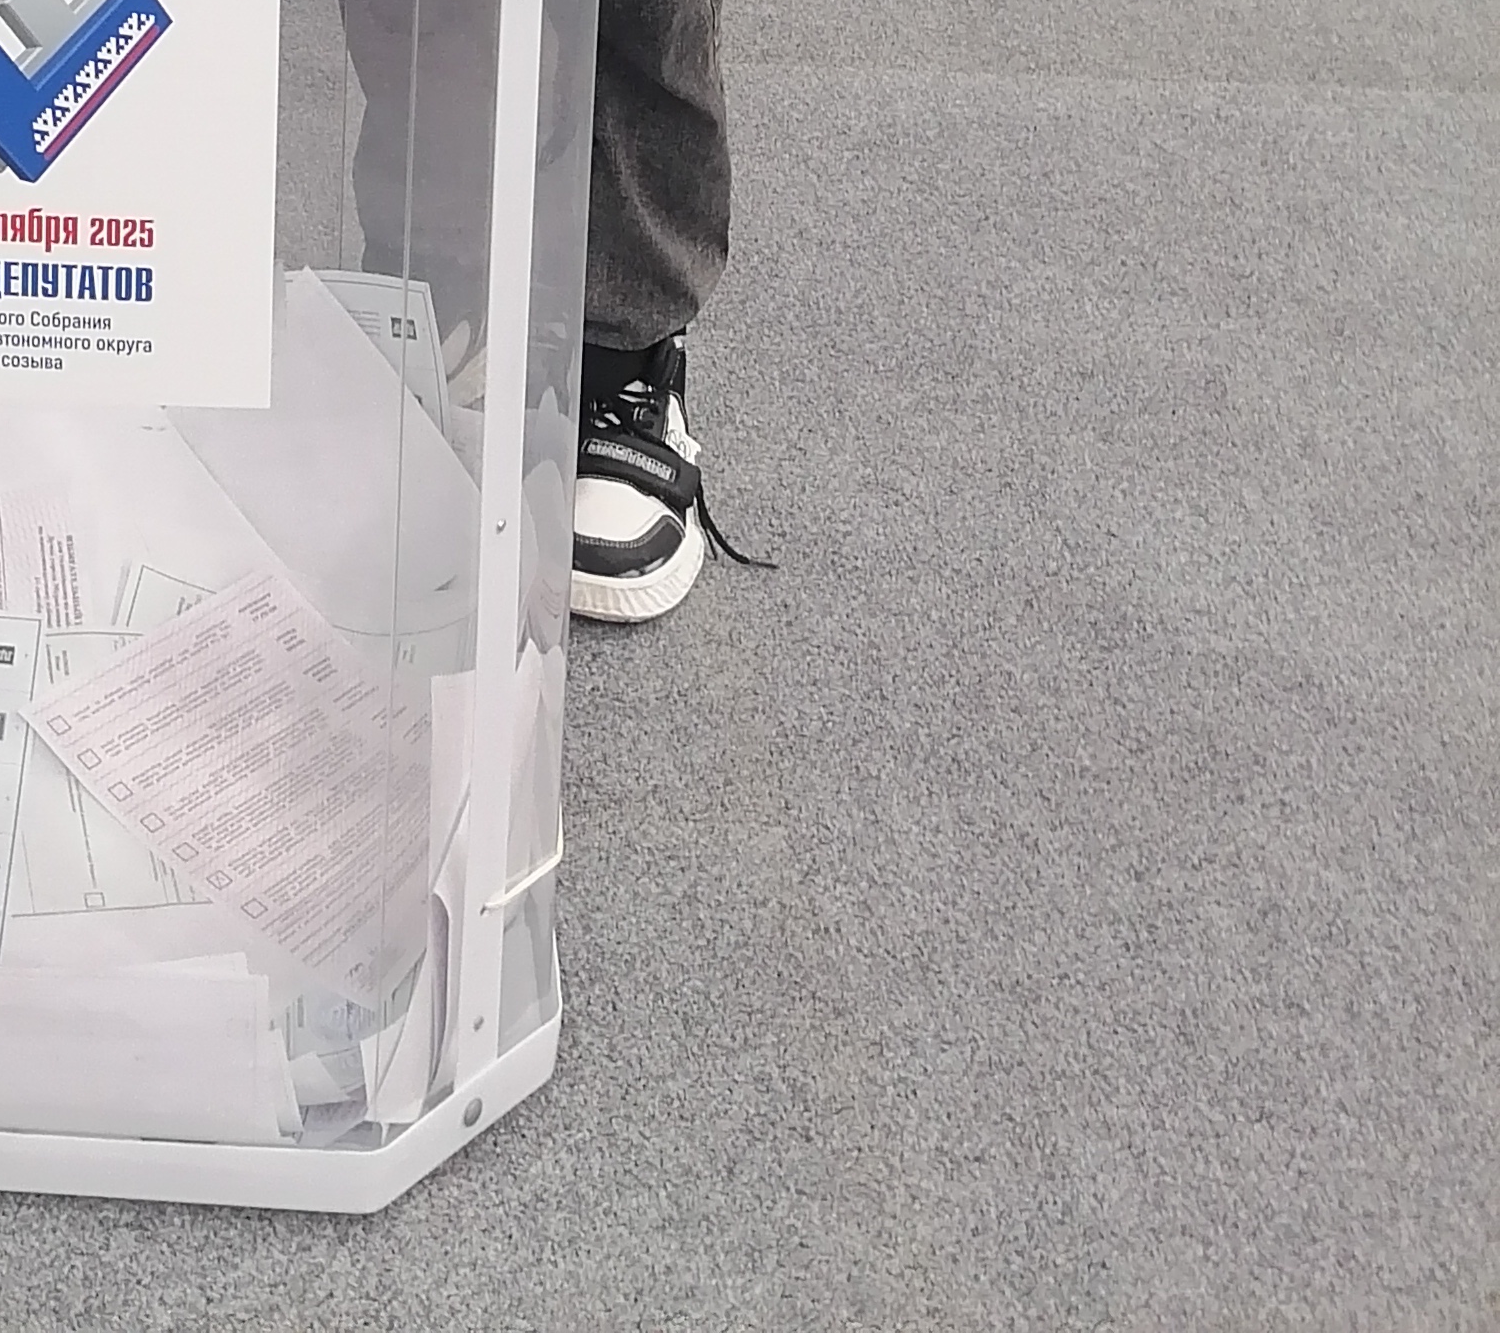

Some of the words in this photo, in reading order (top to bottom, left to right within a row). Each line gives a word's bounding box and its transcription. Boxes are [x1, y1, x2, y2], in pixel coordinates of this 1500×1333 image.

[90, 218, 155, 247] 2025
[30, 311, 112, 331] Собрания
[97, 338, 153, 355] округа
[1, 355, 63, 370] созыва
